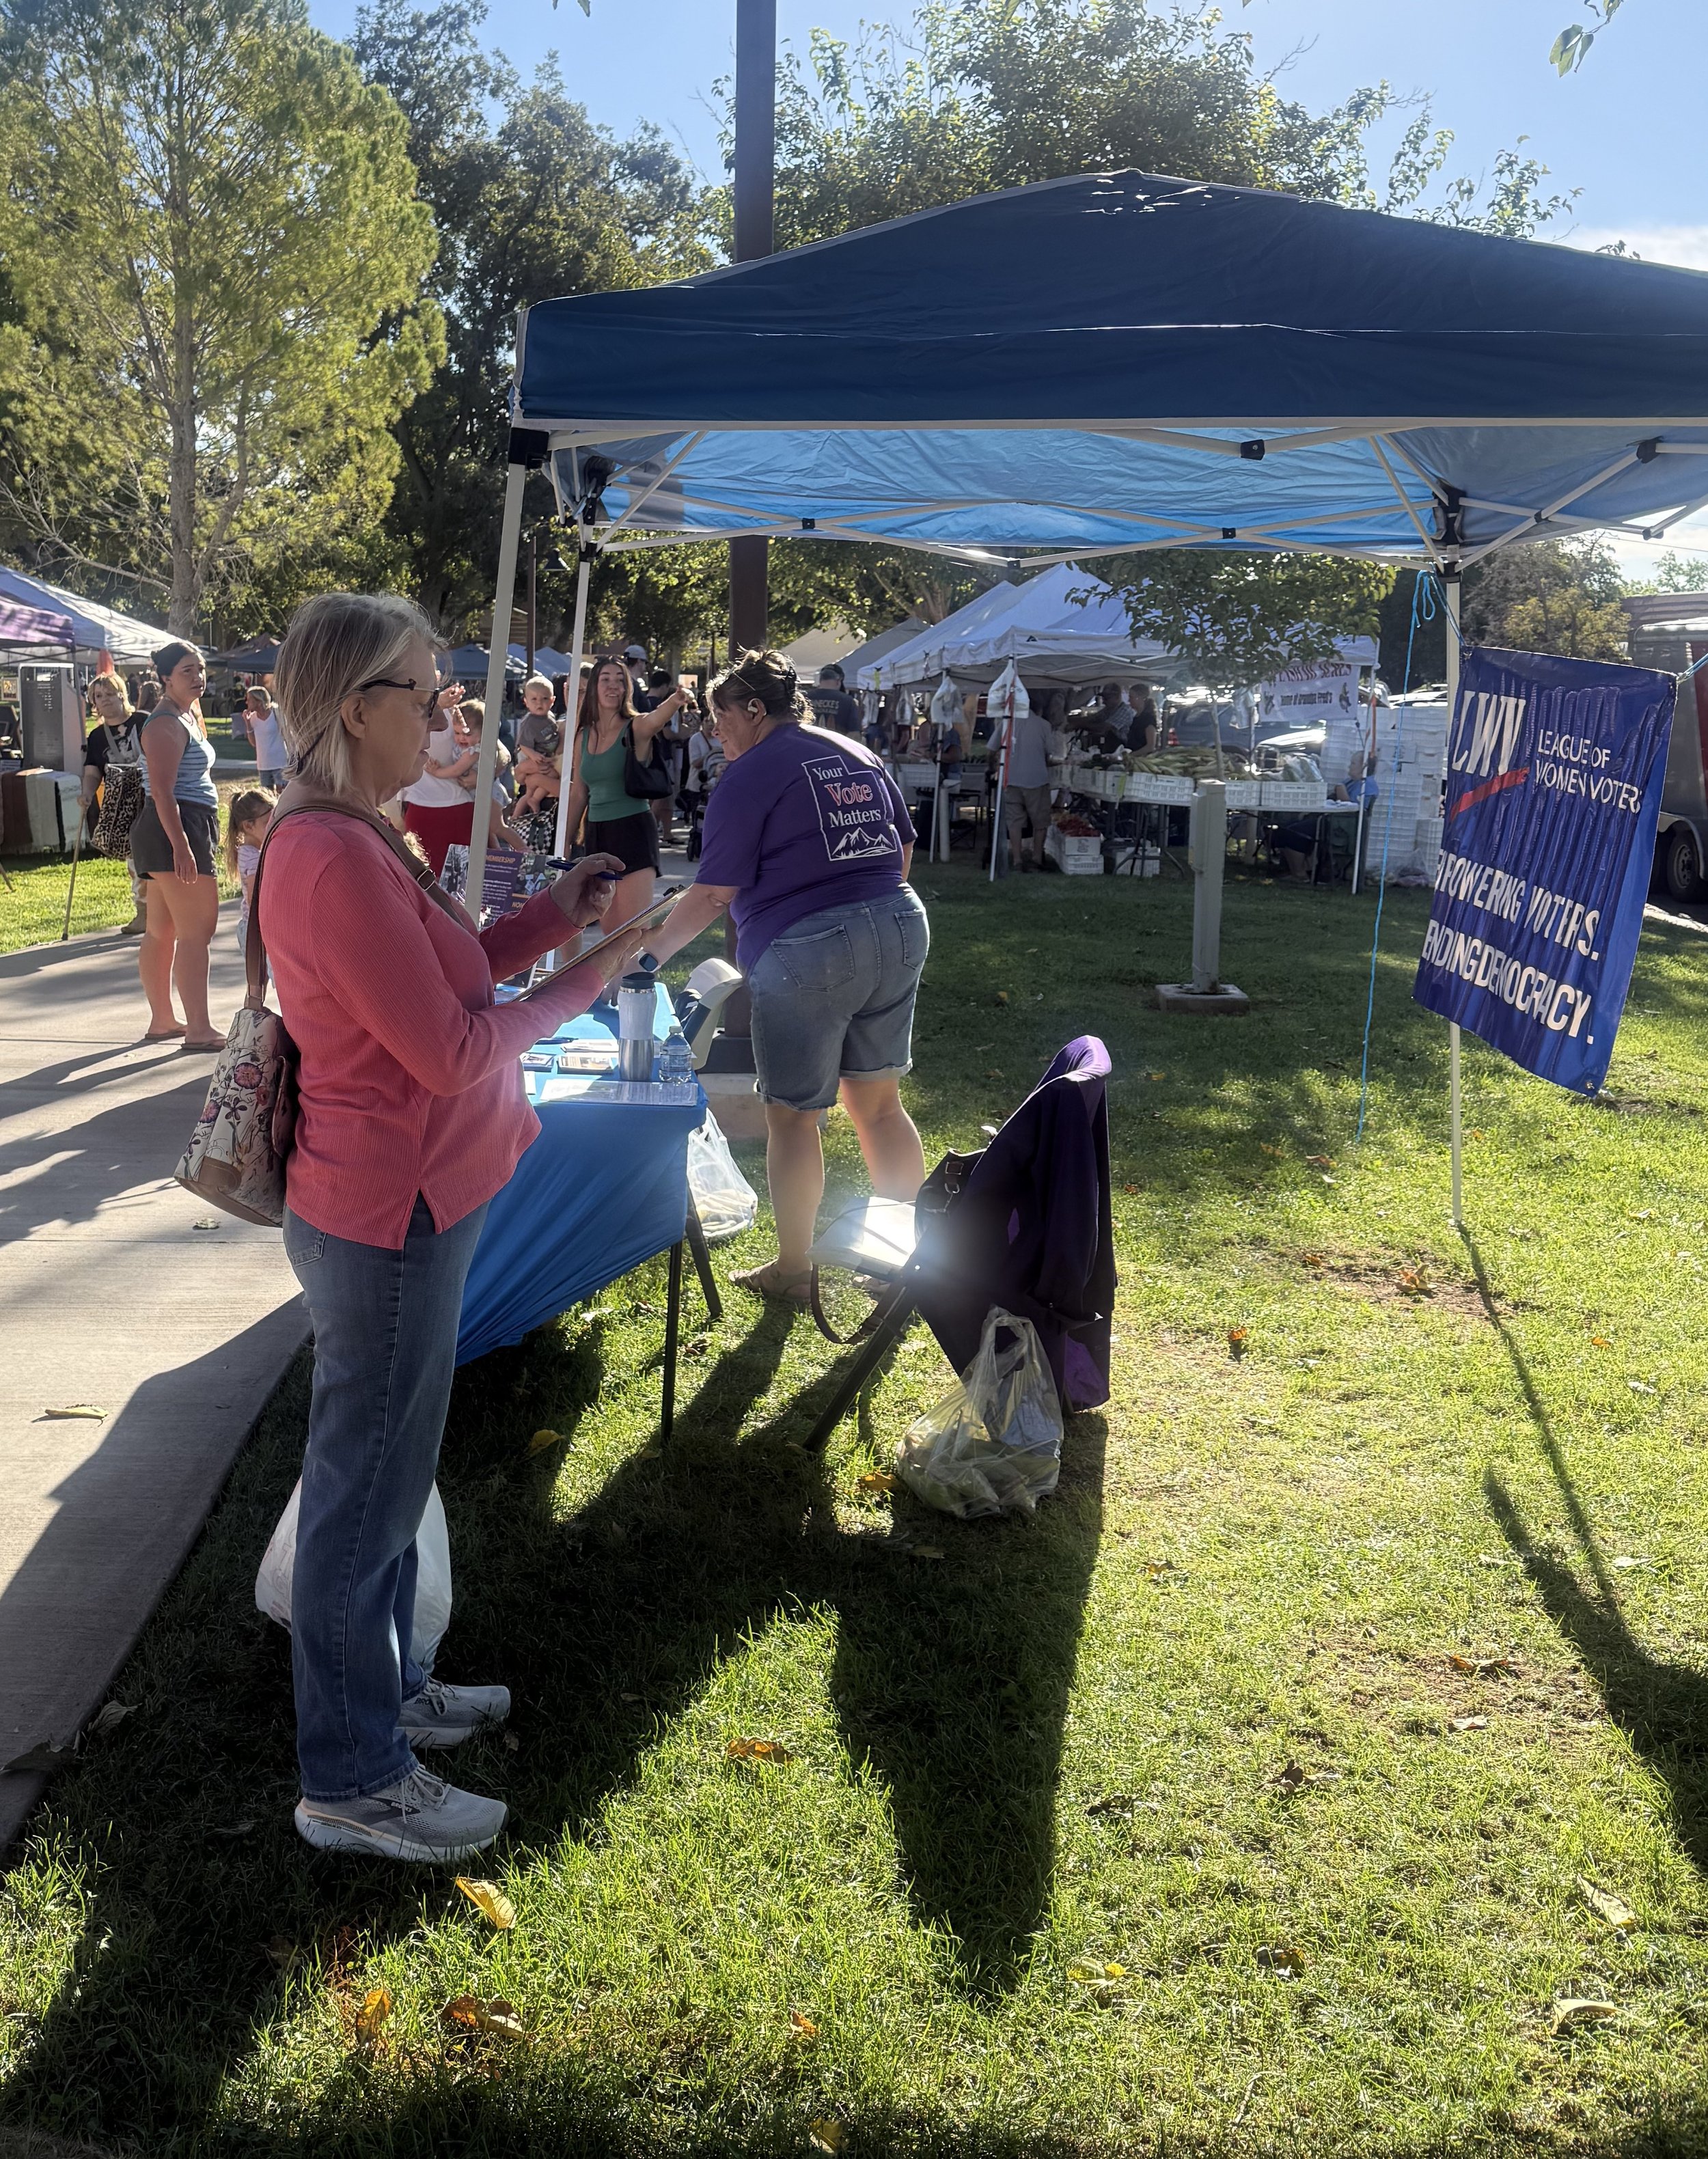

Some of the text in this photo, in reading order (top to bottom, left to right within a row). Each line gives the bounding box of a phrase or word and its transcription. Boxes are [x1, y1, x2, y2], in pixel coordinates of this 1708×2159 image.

[1452, 690, 1526, 777] LWV
[1537, 729, 1611, 769] LEAGUE OF
[812, 767, 844, 781] Your
[1536, 760, 1588, 797] WOMEN
[824, 782, 874, 806] Vote
[828, 809, 881, 828] Matters
[1524, 885, 1600, 961] VOTERS.
[391, 1801, 413, 1813] BROKS
